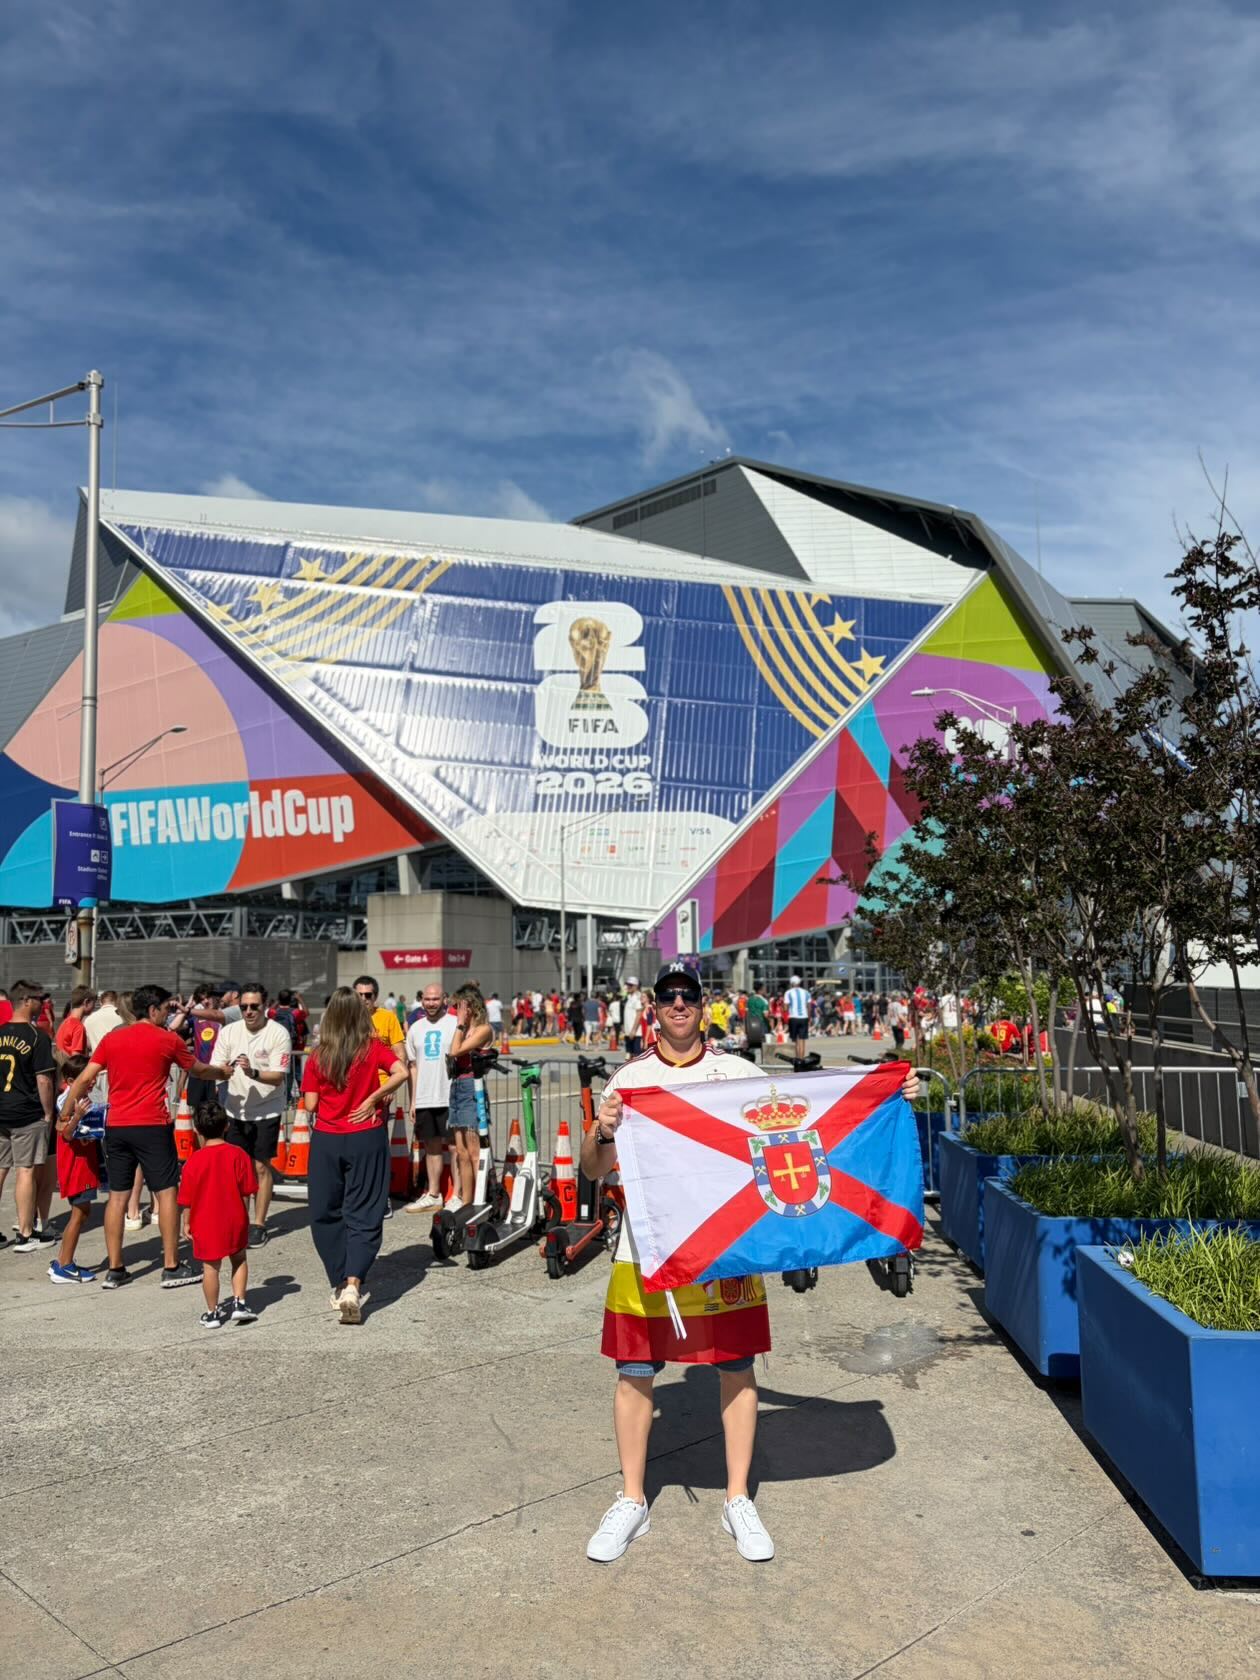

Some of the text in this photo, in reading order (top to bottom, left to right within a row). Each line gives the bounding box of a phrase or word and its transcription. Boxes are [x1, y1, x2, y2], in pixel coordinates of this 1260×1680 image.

[568, 718, 619, 734] FIFA
[536, 754, 651, 769] WORLD CUP
[536, 771, 652, 795] 2026
[104, 789, 355, 847] FIFAWorldCup
[689, 827, 712, 836] VISA
[0, 1035, 32, 1055] NALDO
[0, 1053, 16, 1092] 7
